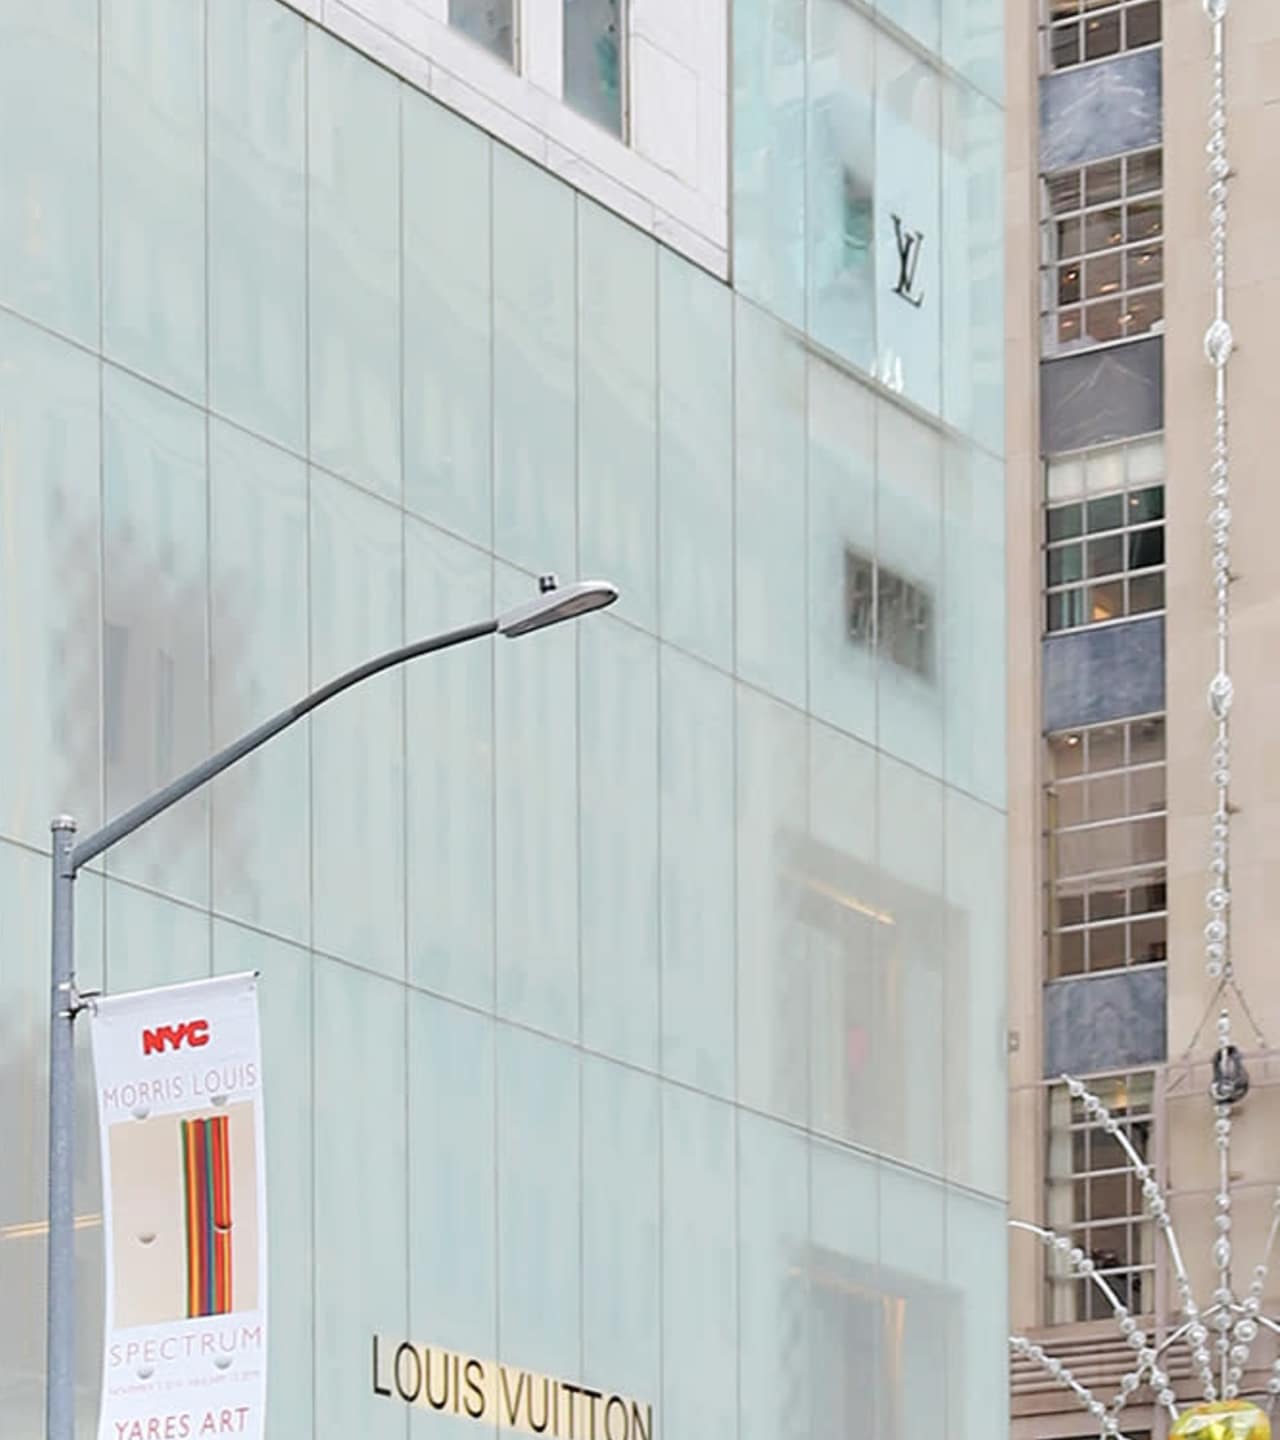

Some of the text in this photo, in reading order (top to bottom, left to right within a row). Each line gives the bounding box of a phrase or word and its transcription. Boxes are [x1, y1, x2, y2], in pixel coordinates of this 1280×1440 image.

[142, 1019, 209, 1055] NYC
[102, 1063, 257, 1109] MORRIS LOUIS
[109, 1326, 262, 1367] SPECTRUM
[373, 1334, 486, 1419] LOUIS
[200, 1407, 250, 1435] ART
